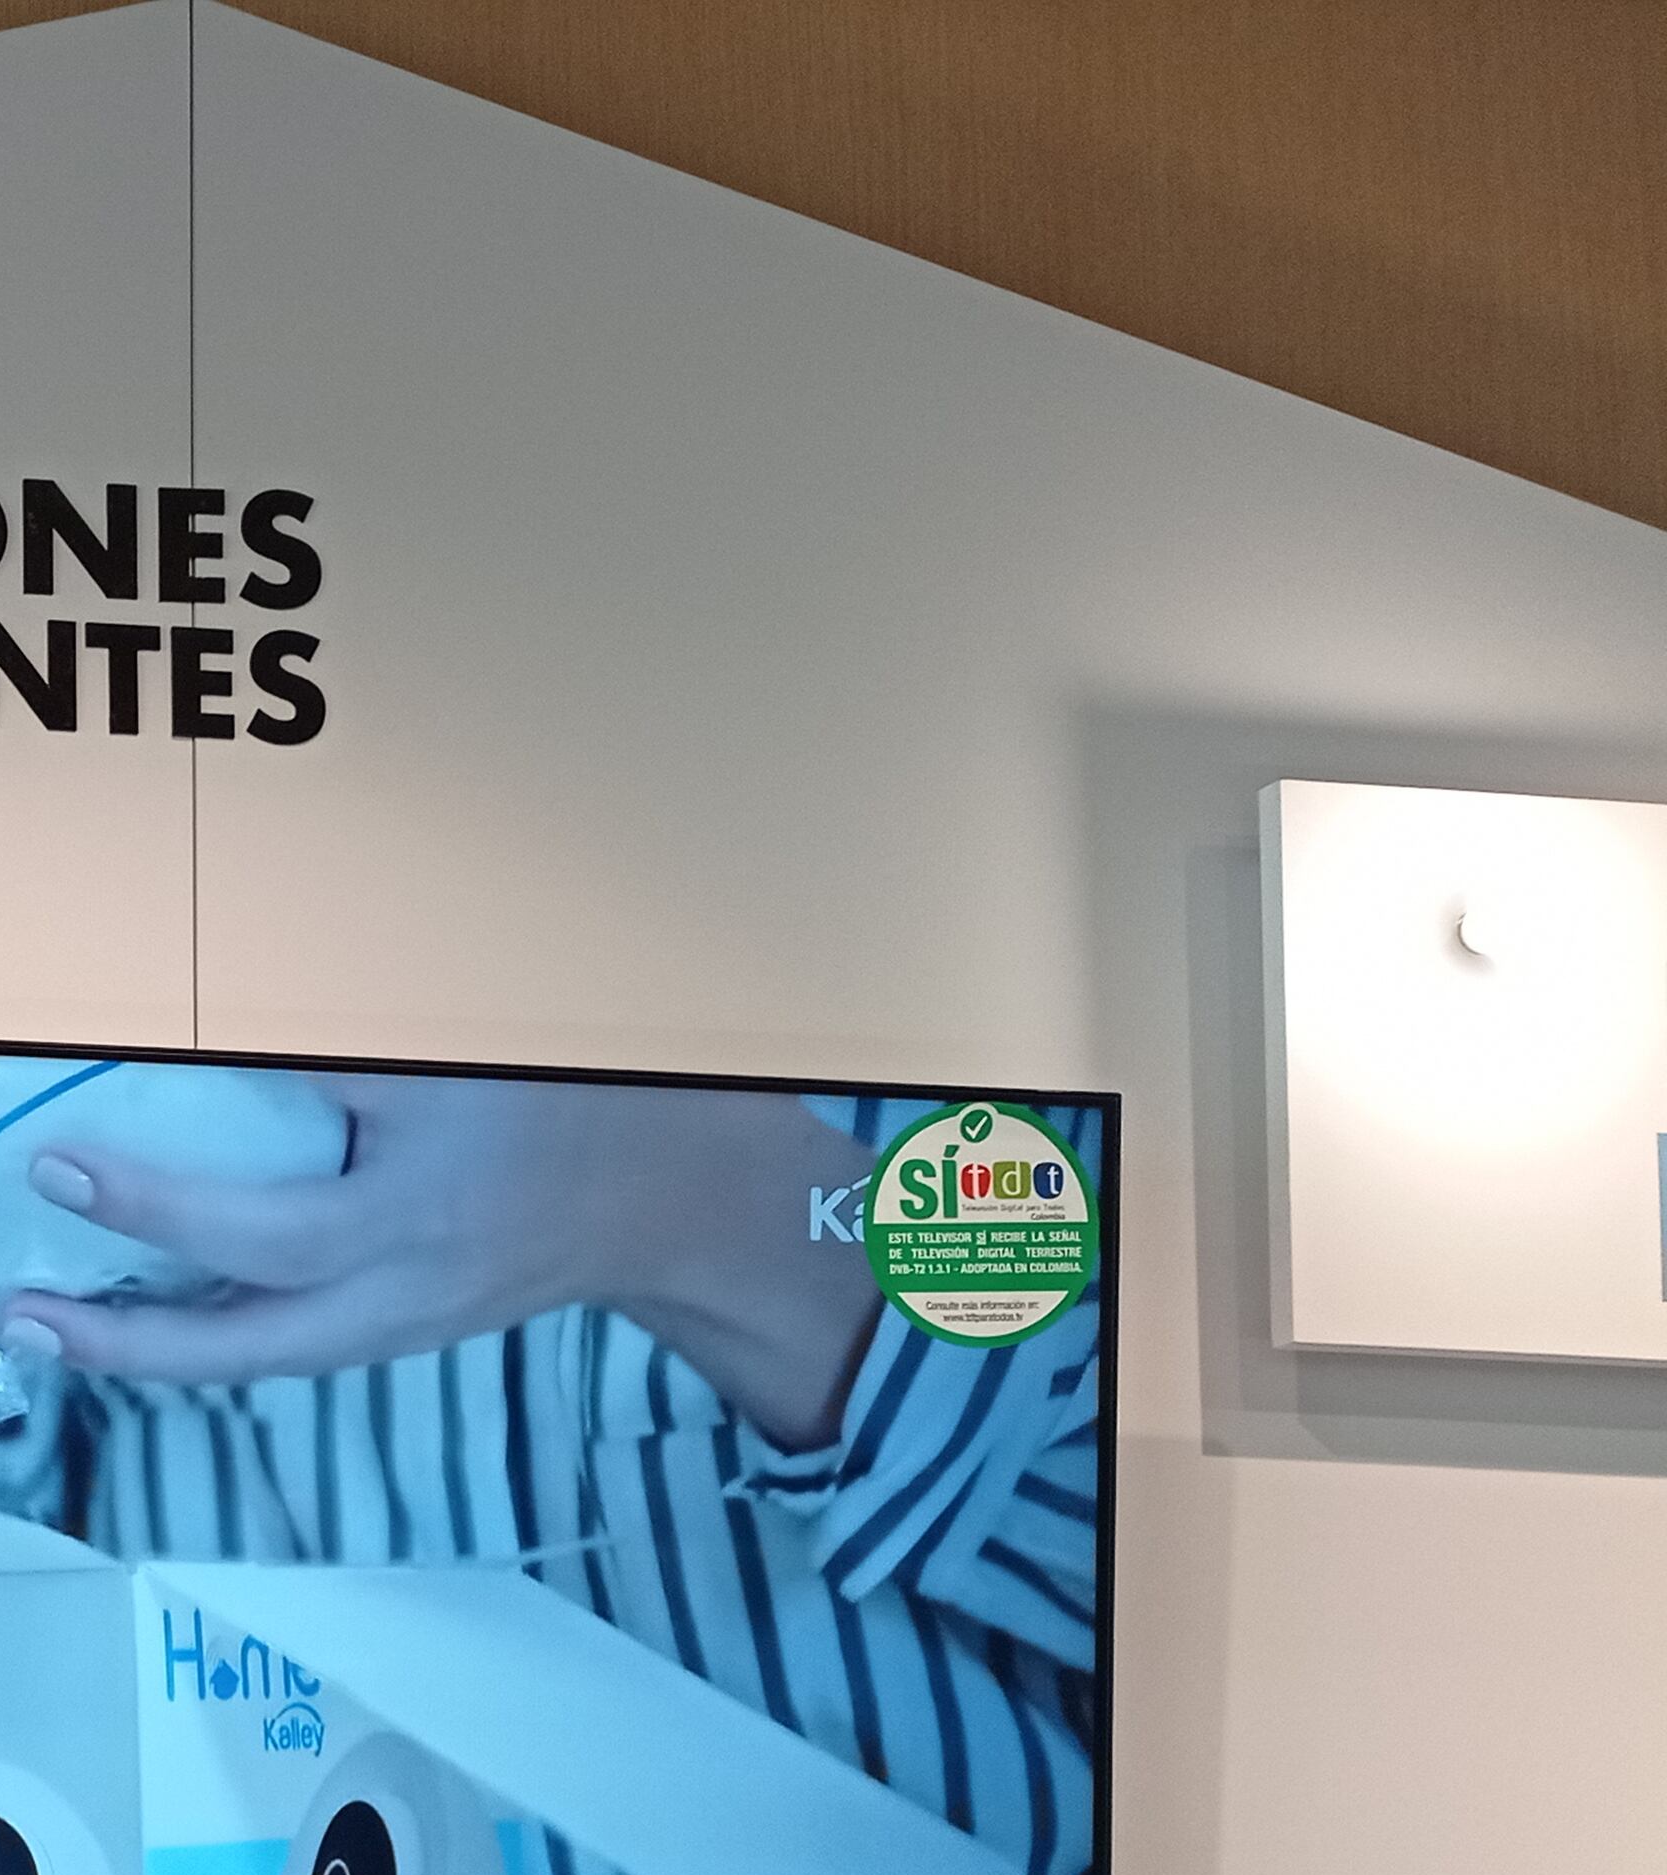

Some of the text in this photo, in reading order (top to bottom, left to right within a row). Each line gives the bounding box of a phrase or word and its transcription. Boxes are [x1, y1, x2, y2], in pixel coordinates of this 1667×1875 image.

[888, 1232, 913, 1244] ESTE
[918, 1232, 972, 1244] TELEVISOR
[990, 1231, 1027, 1243] RECIBE
[1031, 1231, 1045, 1242] LA
[889, 1248, 902, 1260] DE
[977, 1247, 1016, 1259] DIGITAL
[1025, 1247, 1082, 1258] TERRESTRE
[1014, 1263, 1028, 1274] EN
[263, 1714, 325, 1758] Kalley
